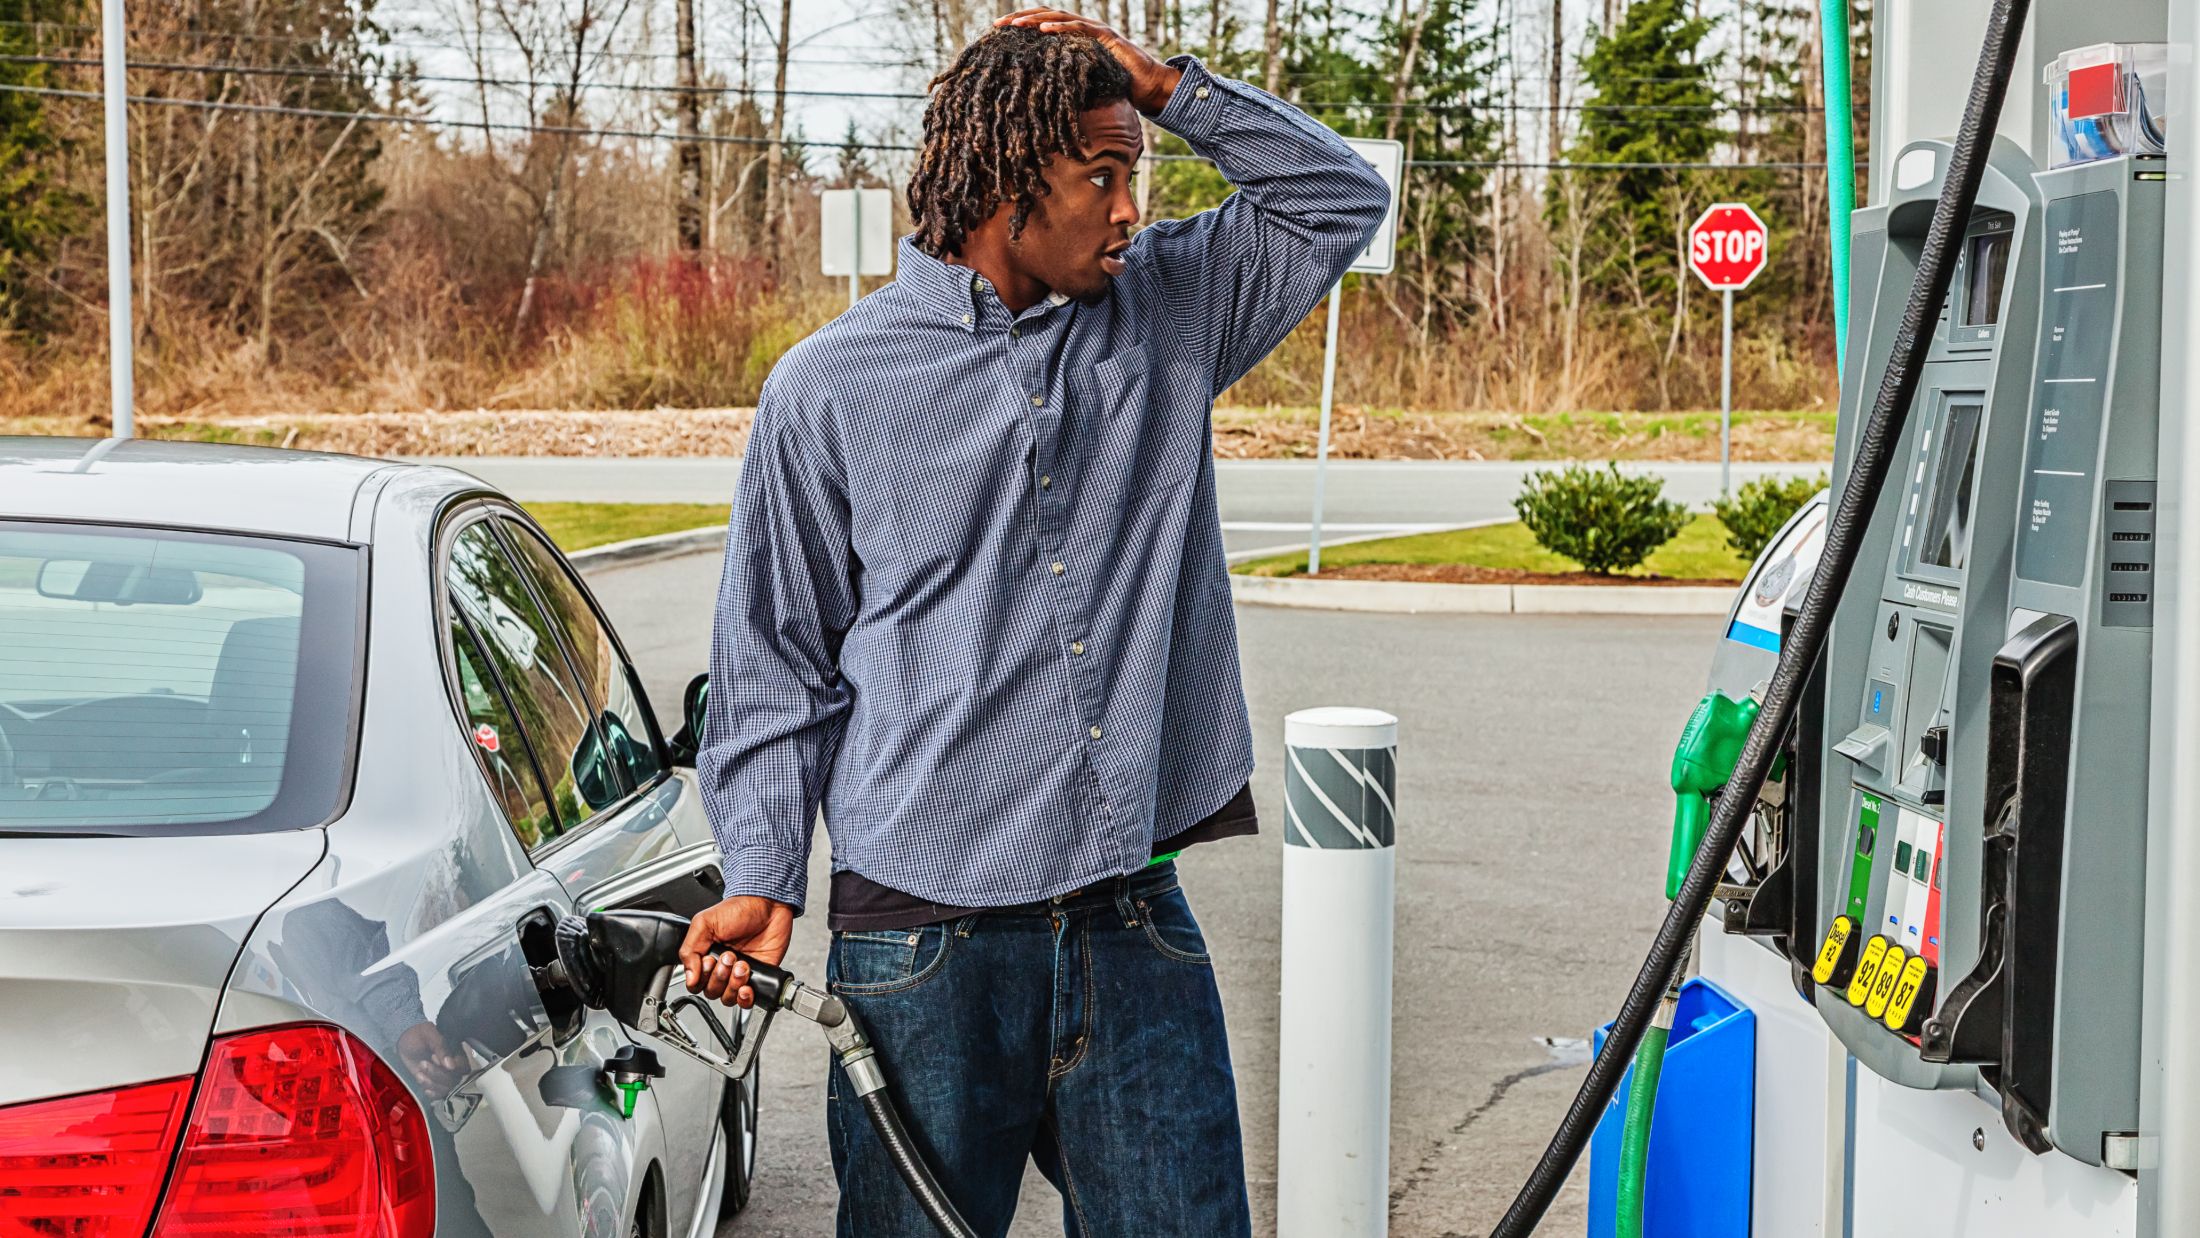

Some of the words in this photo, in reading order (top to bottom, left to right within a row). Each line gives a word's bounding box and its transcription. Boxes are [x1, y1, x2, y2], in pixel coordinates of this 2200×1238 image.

[1694, 230, 1762, 263] STOP
[1904, 584, 1916, 599] Cash
[1916, 585, 1941, 604] Customers
[1941, 590, 1958, 607] Please
[1862, 796, 1872, 810] Diesel
[1829, 923, 1849, 946] Diesel
[1825, 944, 1837, 962] #2
[1858, 959, 1875, 988] 92
[1876, 971, 1893, 999] 89
[1895, 981, 1915, 1010] 87
